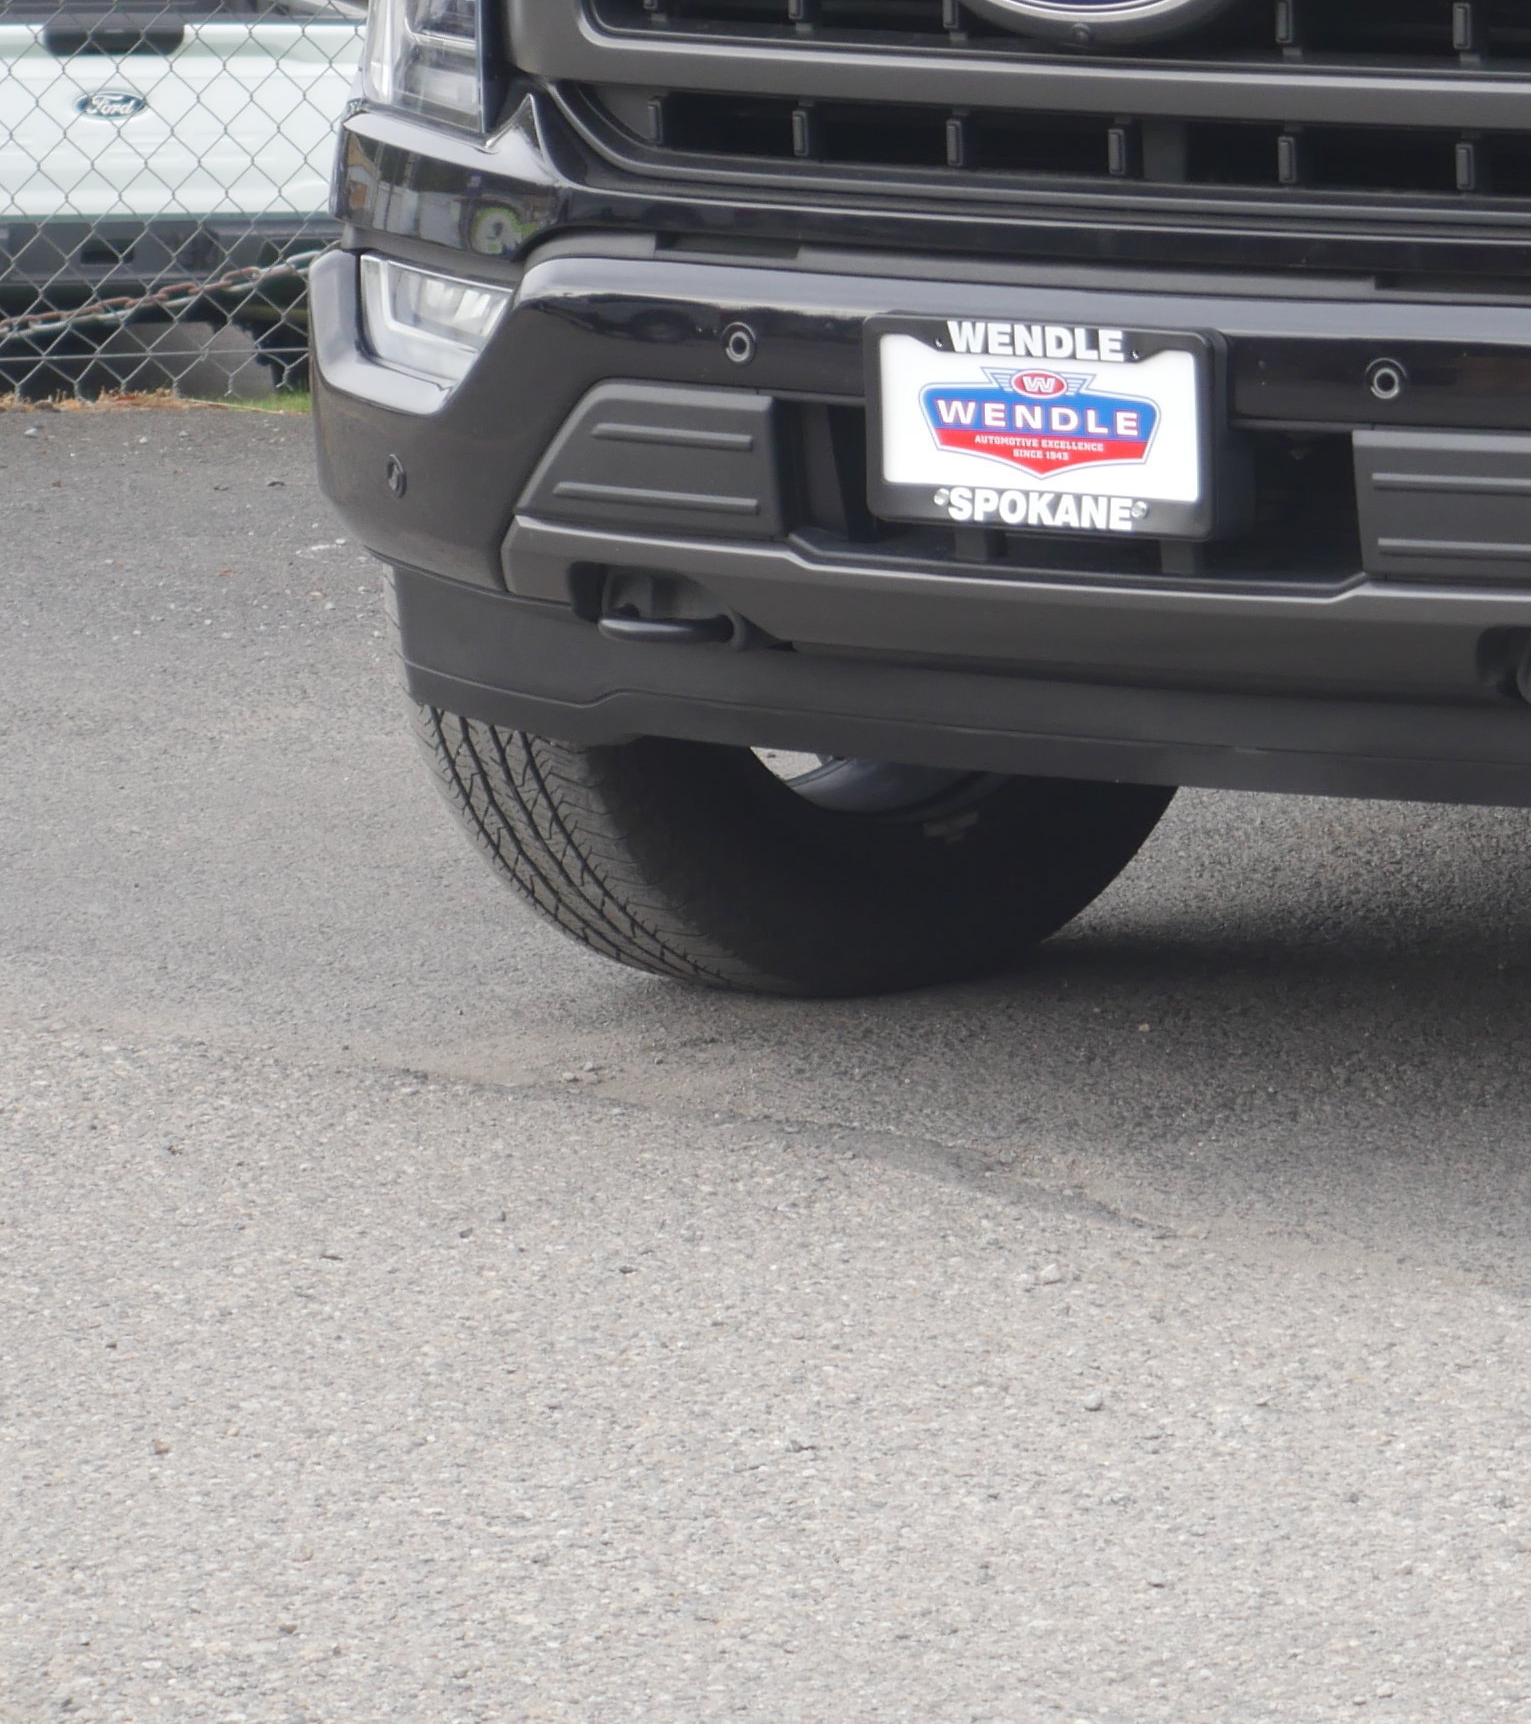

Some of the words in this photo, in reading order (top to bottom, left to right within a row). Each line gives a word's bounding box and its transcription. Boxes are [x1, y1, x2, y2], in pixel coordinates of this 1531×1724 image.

[86, 94, 136, 115] Ford
[947, 320, 1125, 363] WENDLE
[935, 398, 1140, 437] WENDLE
[974, 434, 1040, 448] AUTOMOTIVE
[1040, 439, 1104, 453] EXCELLENCE
[1012, 448, 1044, 460] SINCE
[947, 486, 1133, 531] SPOKANE
